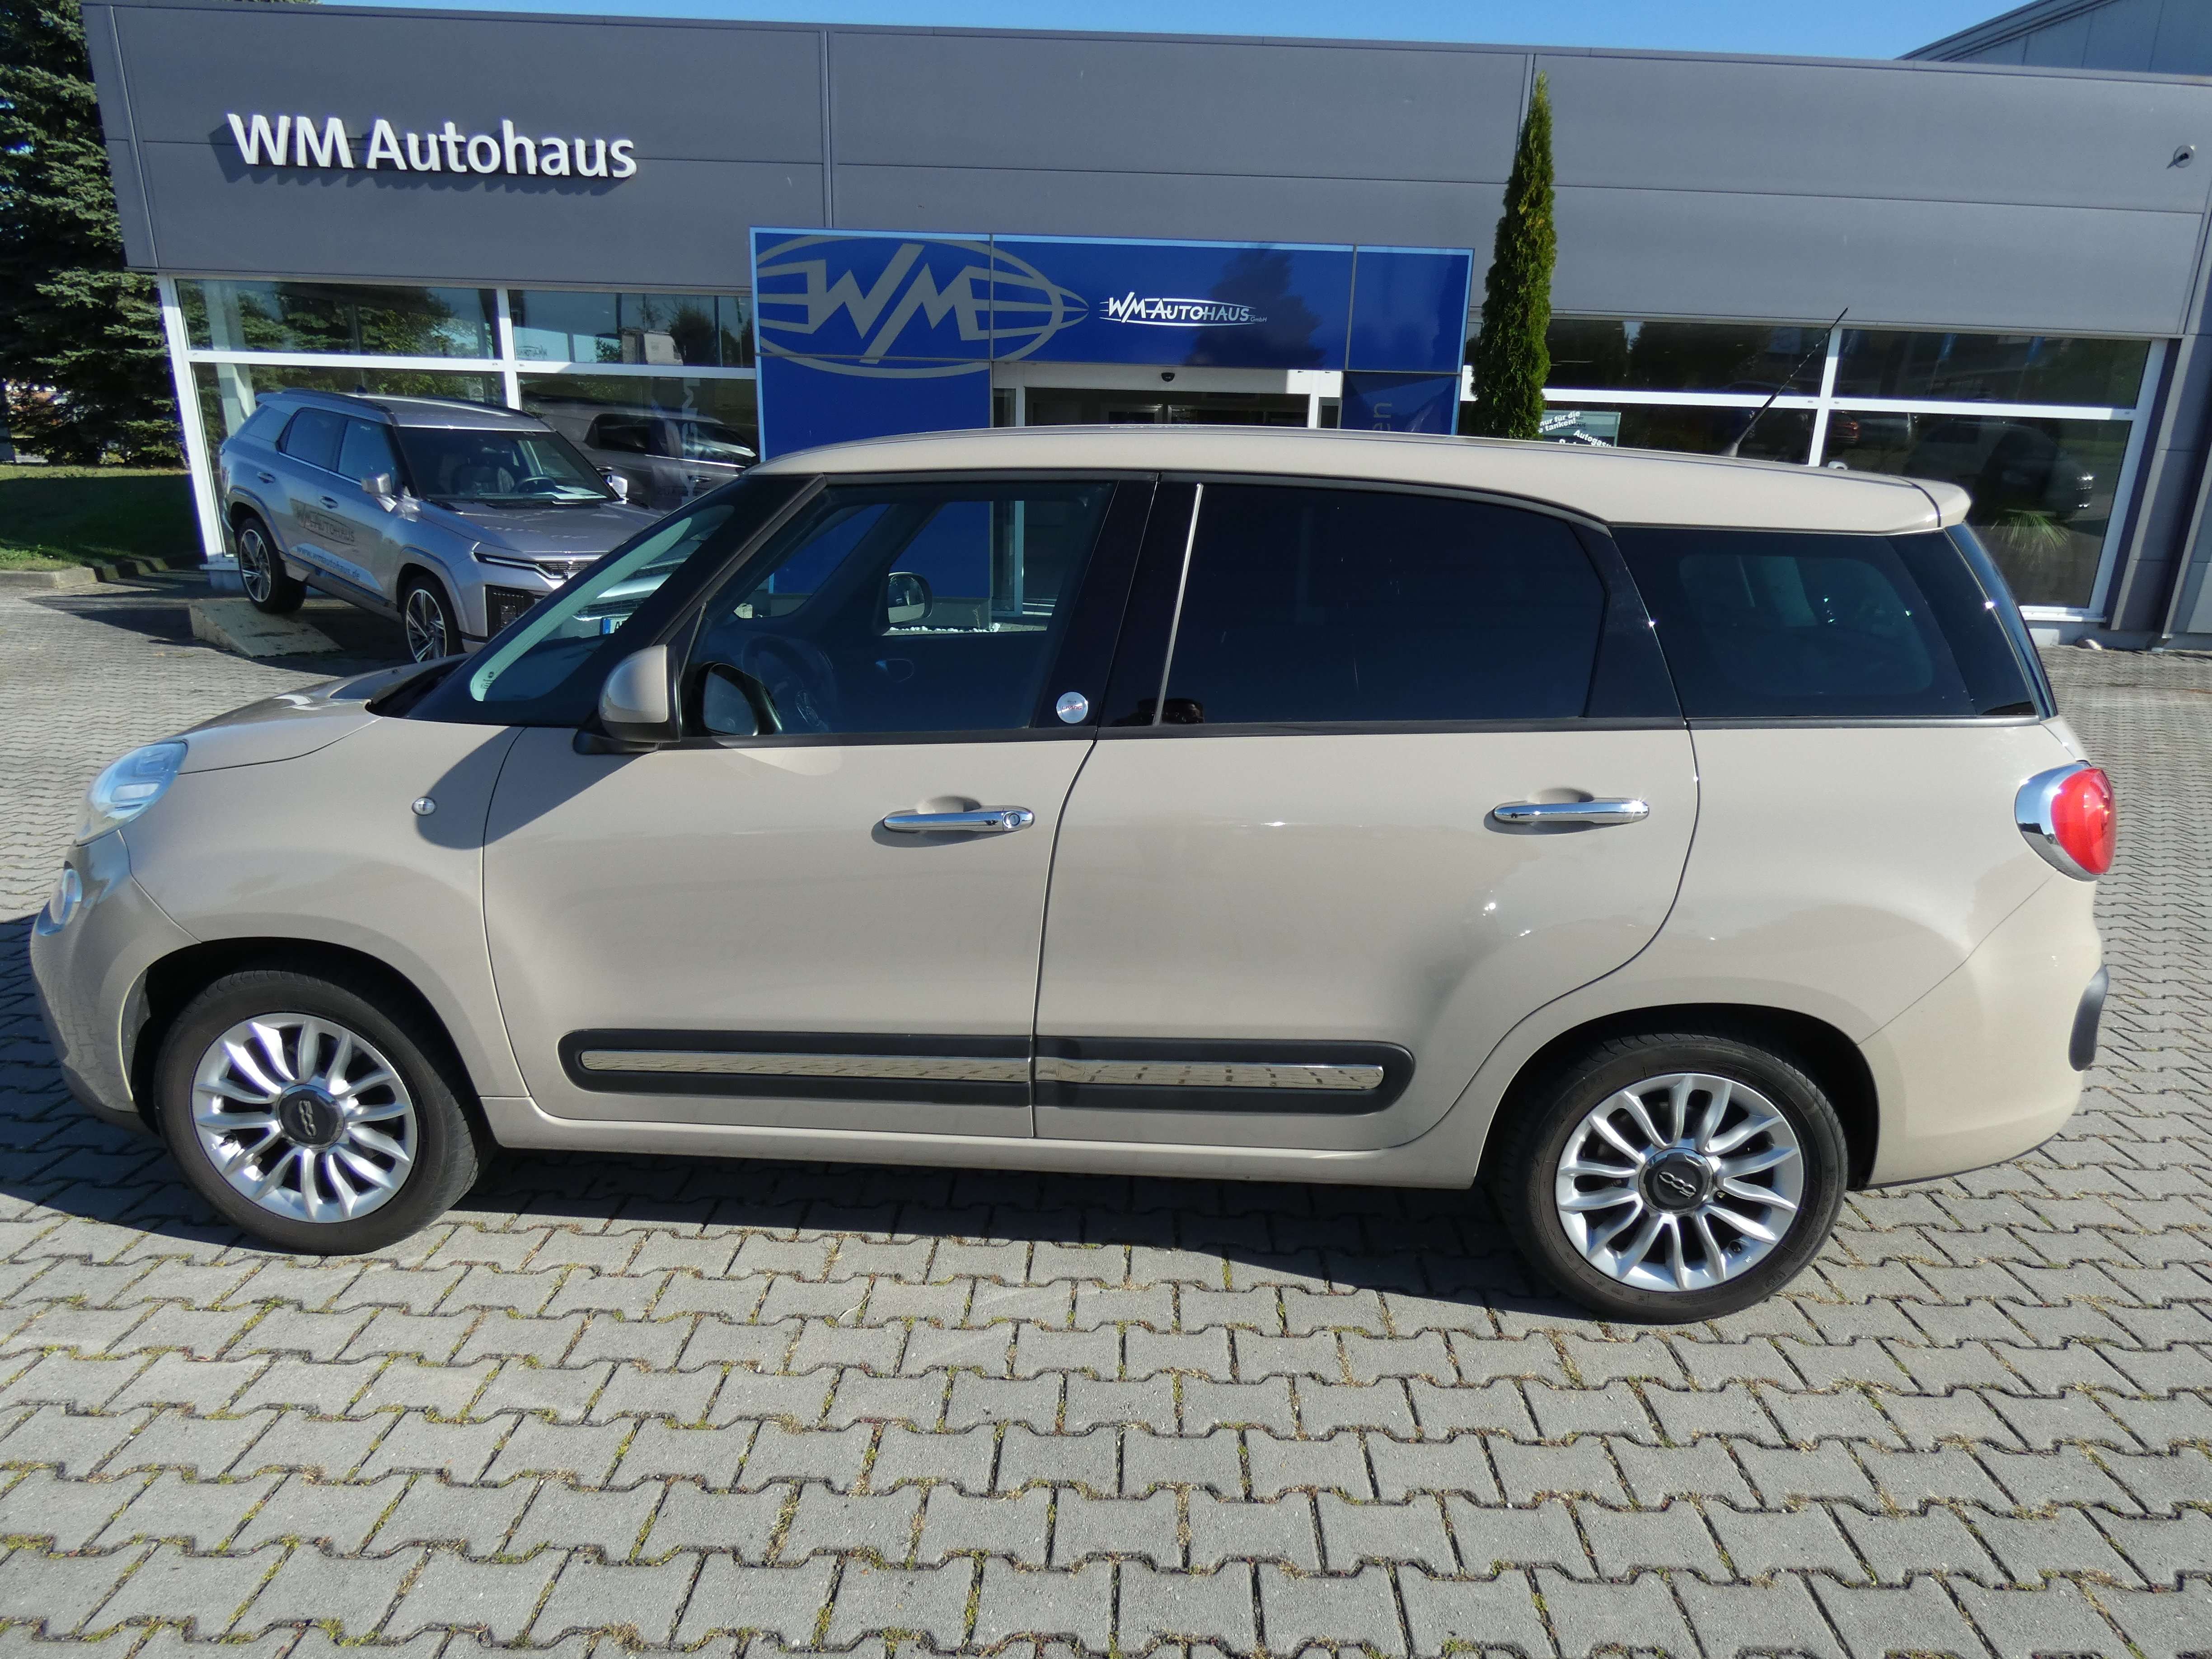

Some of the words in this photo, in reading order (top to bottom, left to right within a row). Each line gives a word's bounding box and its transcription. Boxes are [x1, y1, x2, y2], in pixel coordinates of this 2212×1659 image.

[228, 113, 354, 169] WM
[366, 119, 637, 178] Autohaus
[1109, 292, 1146, 323] WM
[1150, 298, 1250, 321] AUTOHAUS
[1540, 418, 1553, 426] nur
[1545, 417, 1576, 431] tanken!
